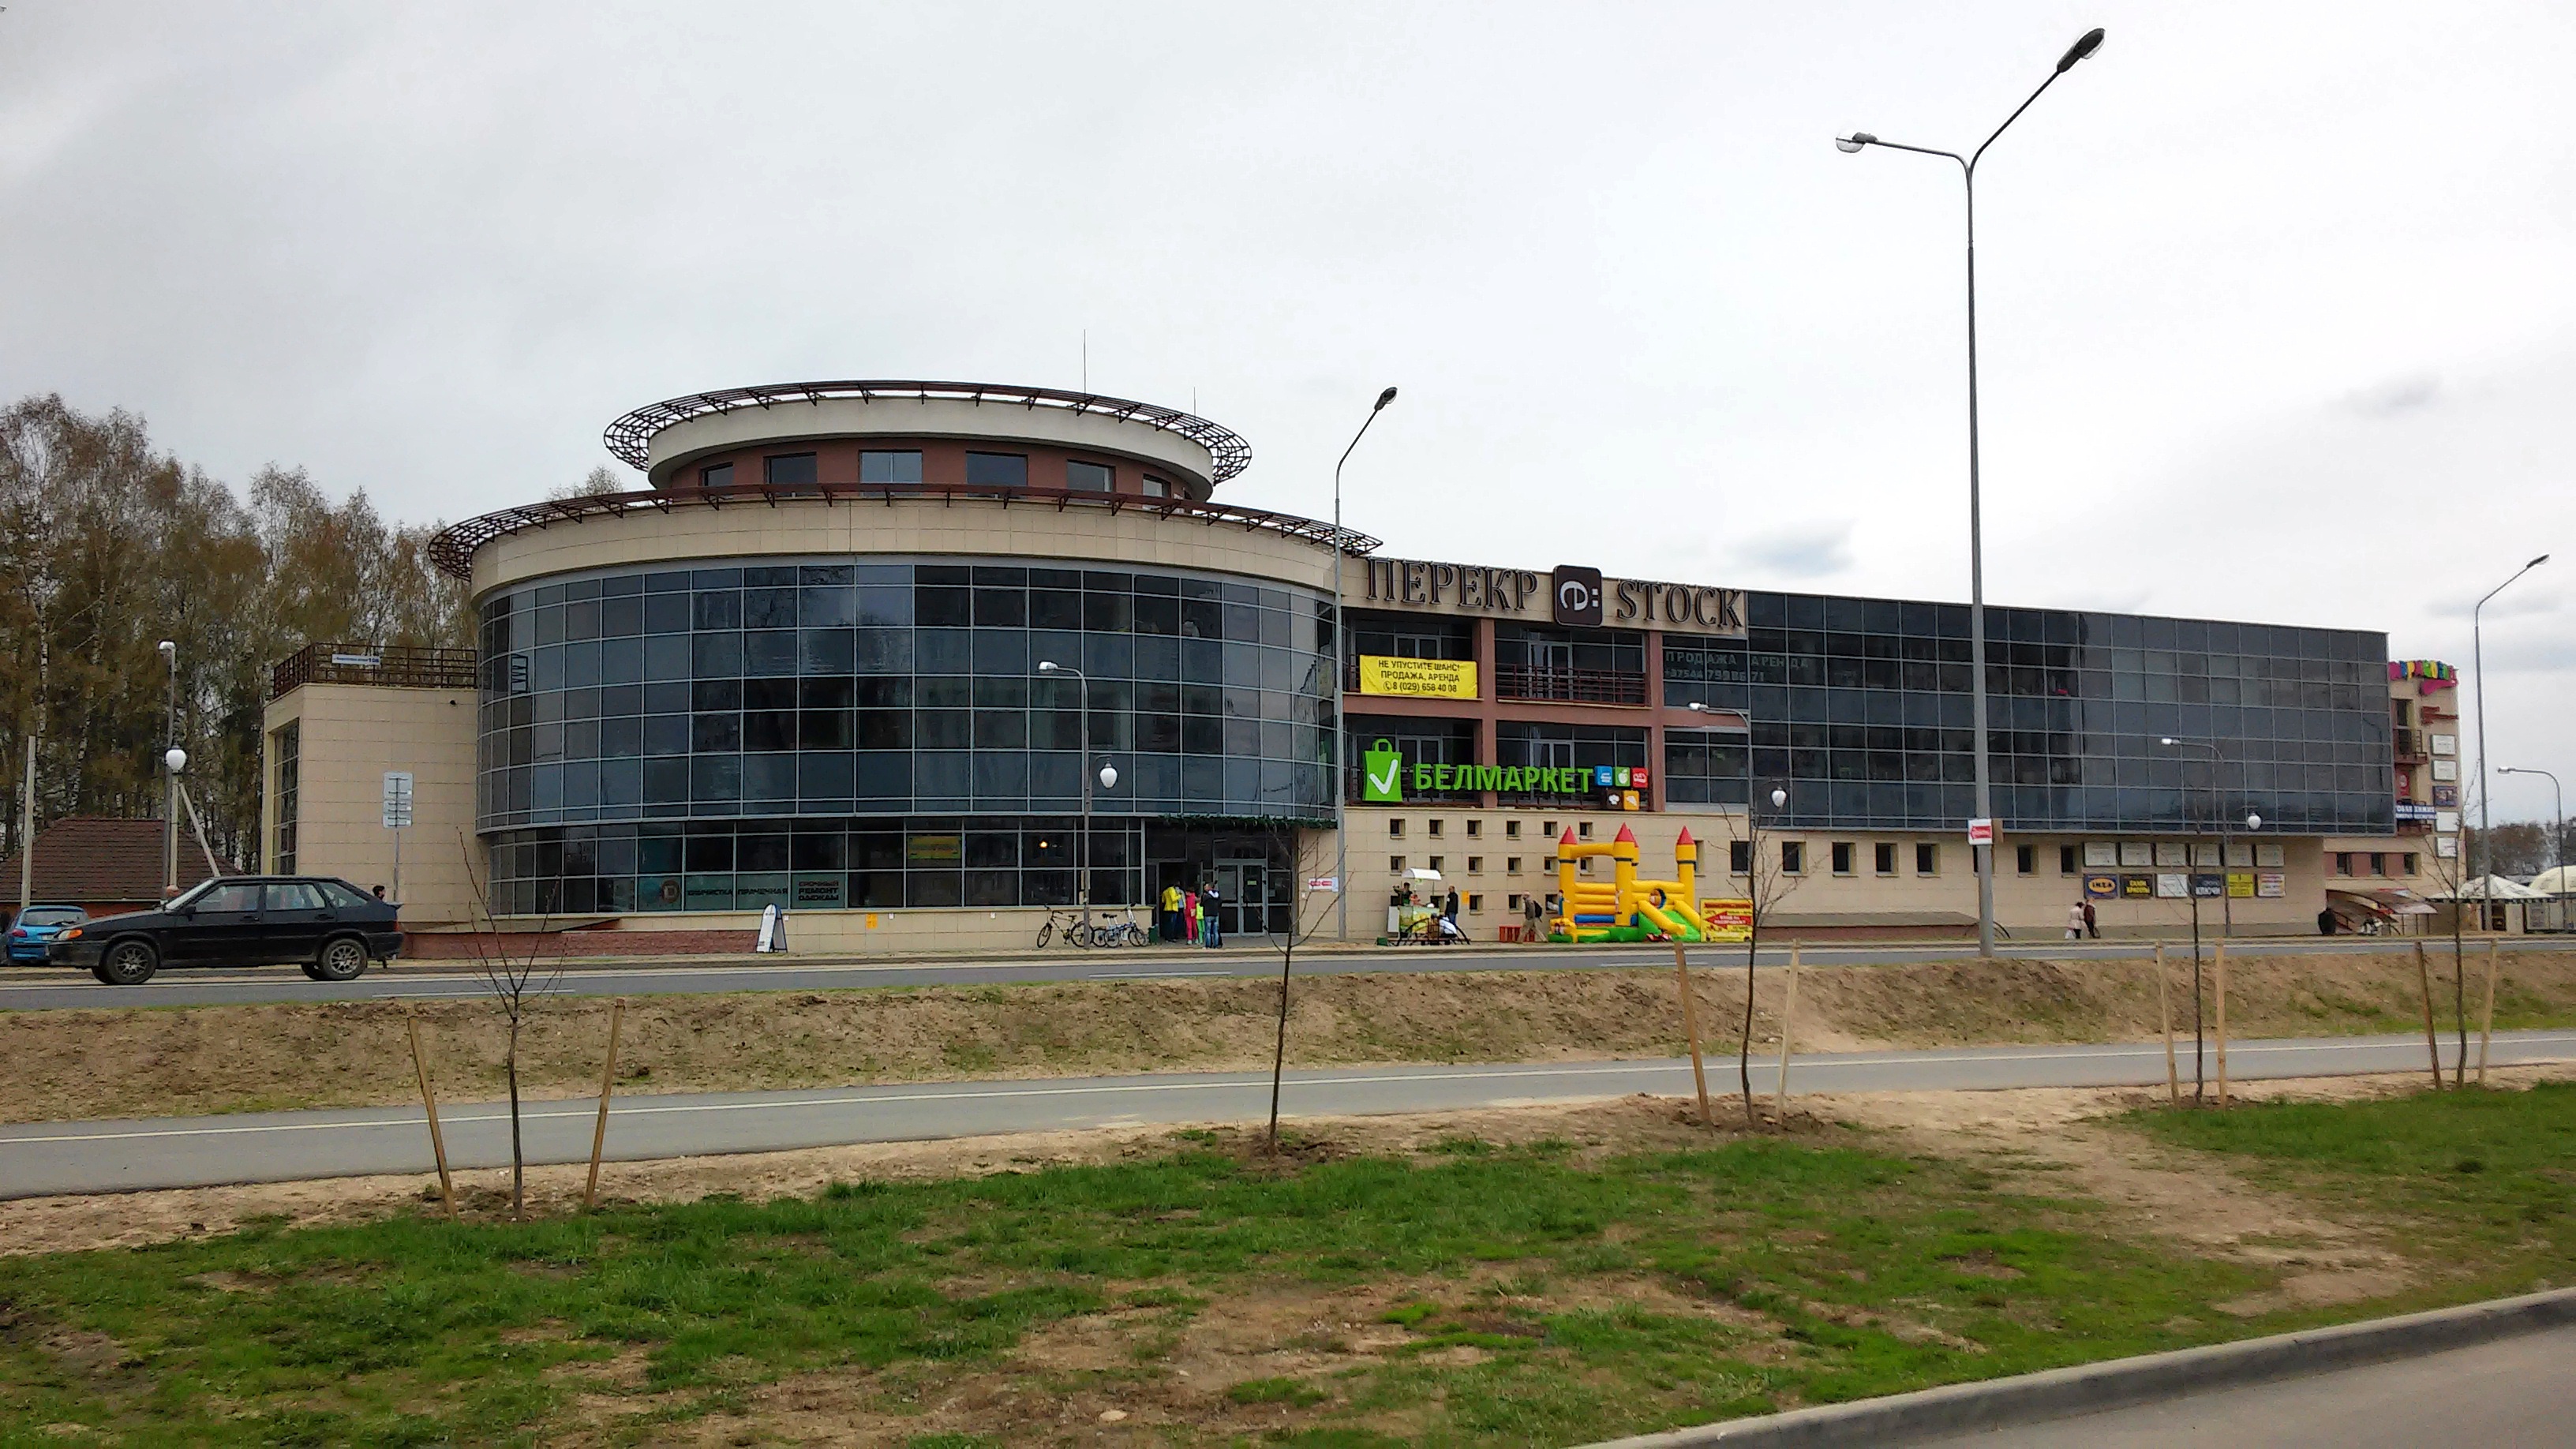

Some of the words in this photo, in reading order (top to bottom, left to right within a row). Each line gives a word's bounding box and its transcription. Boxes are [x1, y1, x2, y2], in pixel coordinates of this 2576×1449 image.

[1365, 556, 1538, 612] ПЕРЕКР
[1616, 578, 1744, 628] STOCK
[1665, 651, 1737, 665] ПРОДАЖА
[1378, 660, 1389, 668] НЕ
[1391, 661, 1432, 671] УПУСТИТЕ
[1434, 663, 1460, 672] ШАНС!
[1380, 671, 1426, 681] ПРОДАЖА,
[1428, 673, 1460, 682] АРЕНДА
[1399, 682, 1421, 692] (029)
[1413, 763, 1594, 794] БЕЛМАРКЕТ
[737, 887, 788, 896] ПРАЧЕЧНАЯ
